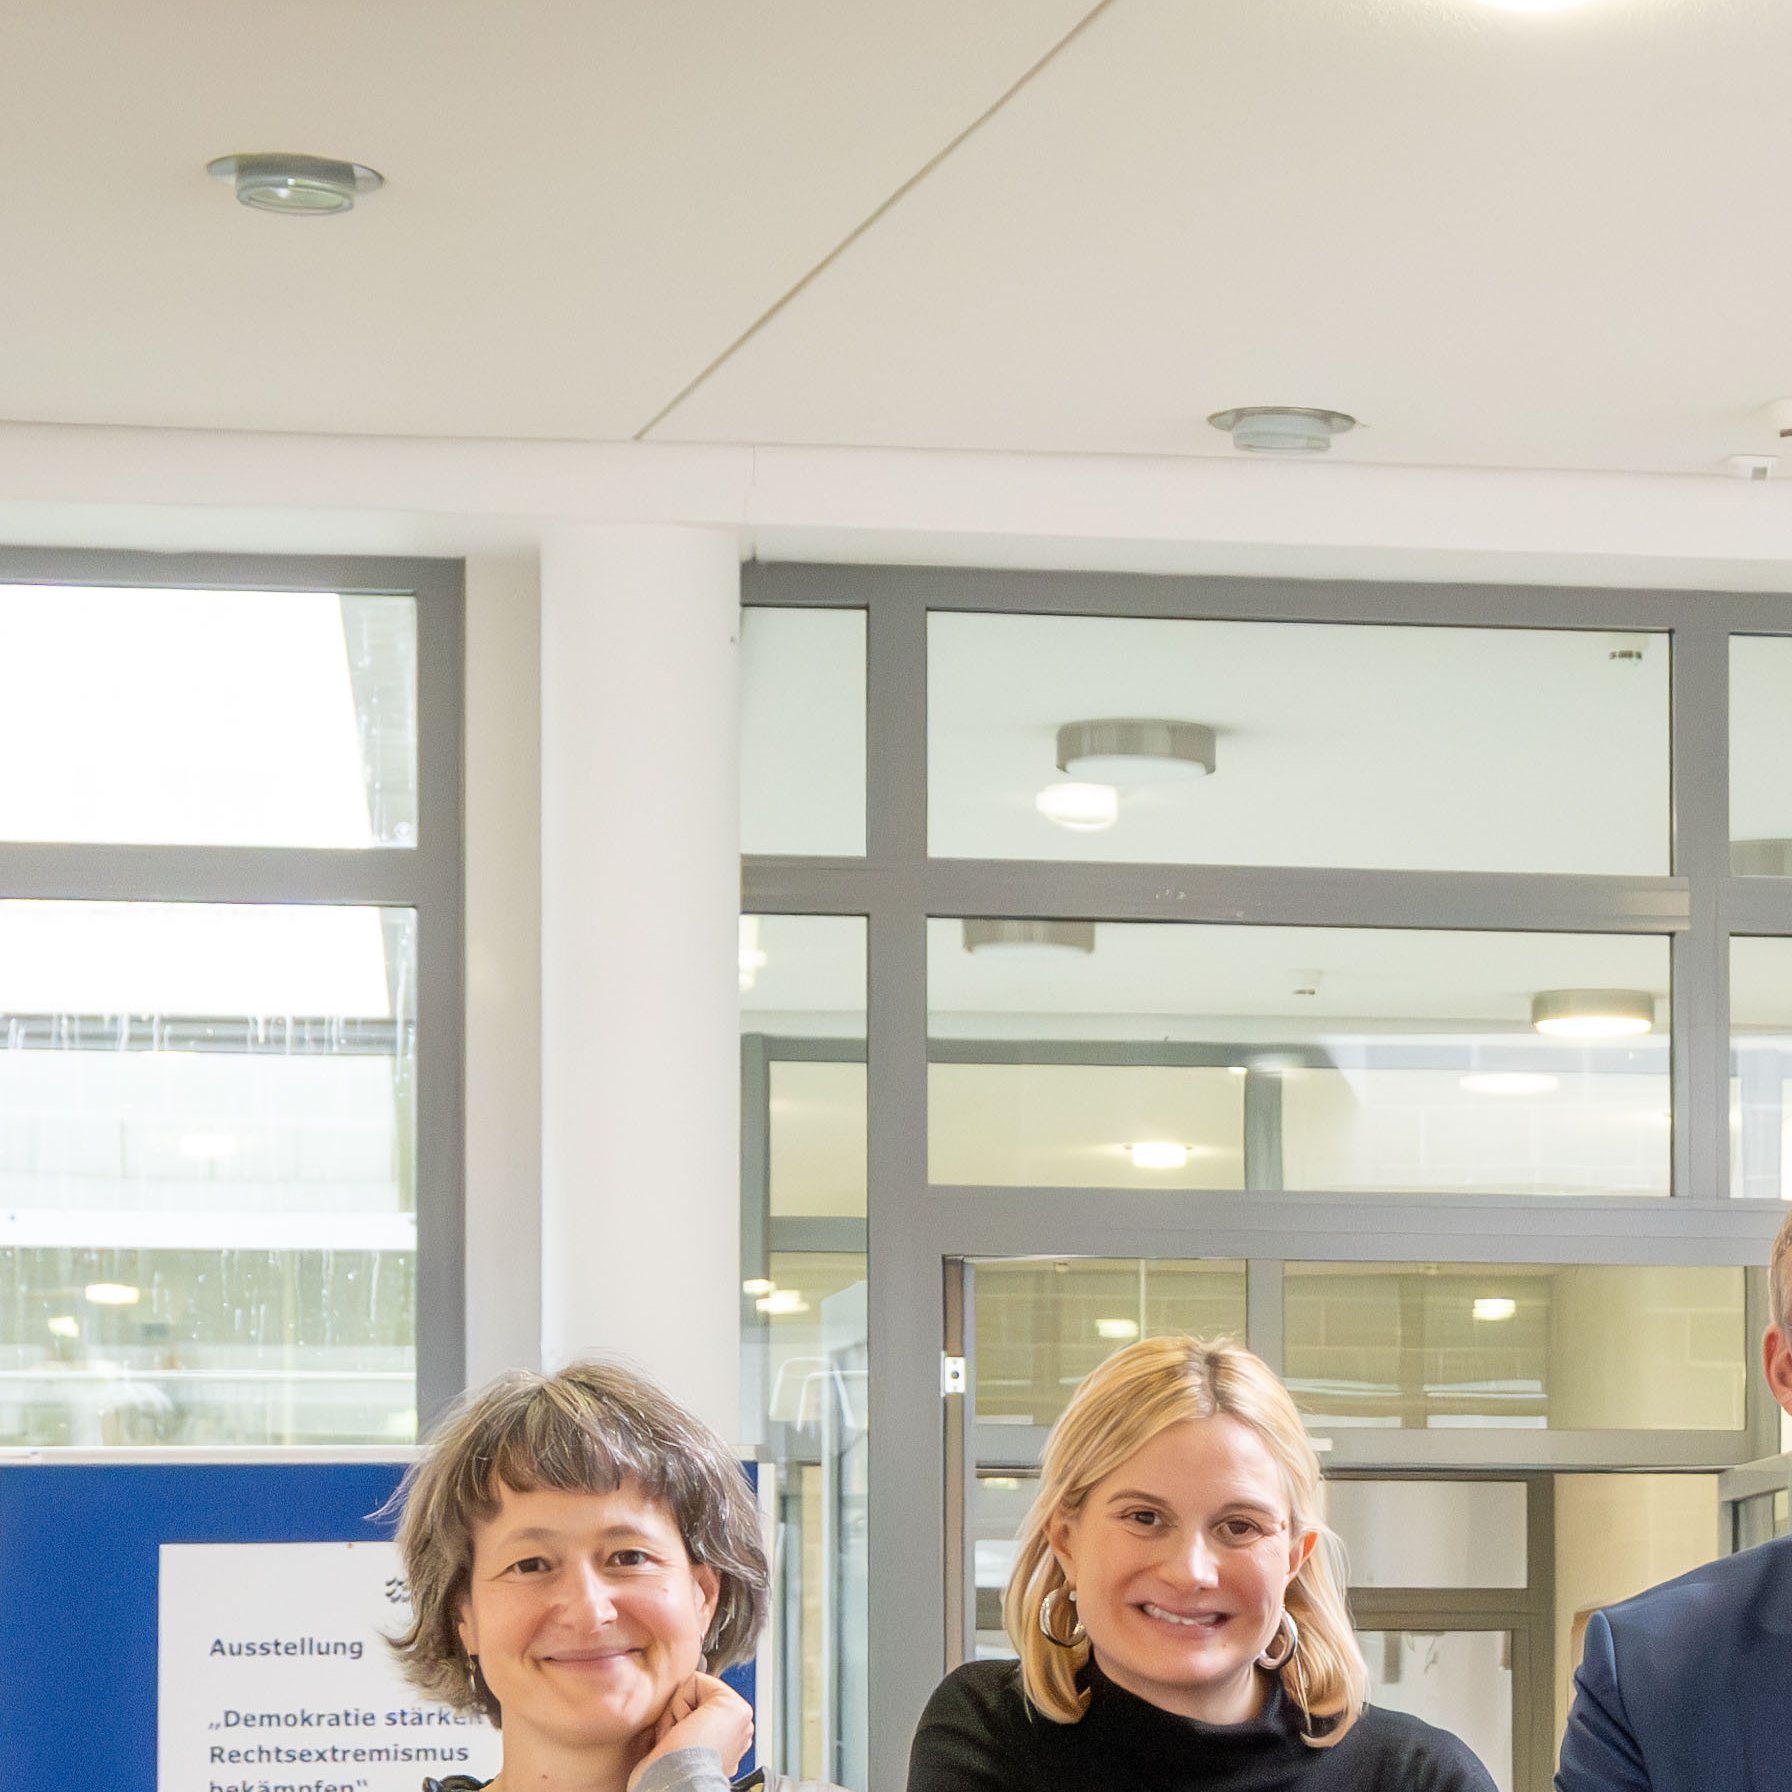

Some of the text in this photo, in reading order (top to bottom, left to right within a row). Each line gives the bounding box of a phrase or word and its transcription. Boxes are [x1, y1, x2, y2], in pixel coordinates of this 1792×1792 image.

[209, 1637, 363, 1659] Ausstellung
[208, 1707, 376, 1731] „Demokratie
[209, 1744, 470, 1764] Rechtsextremismus
